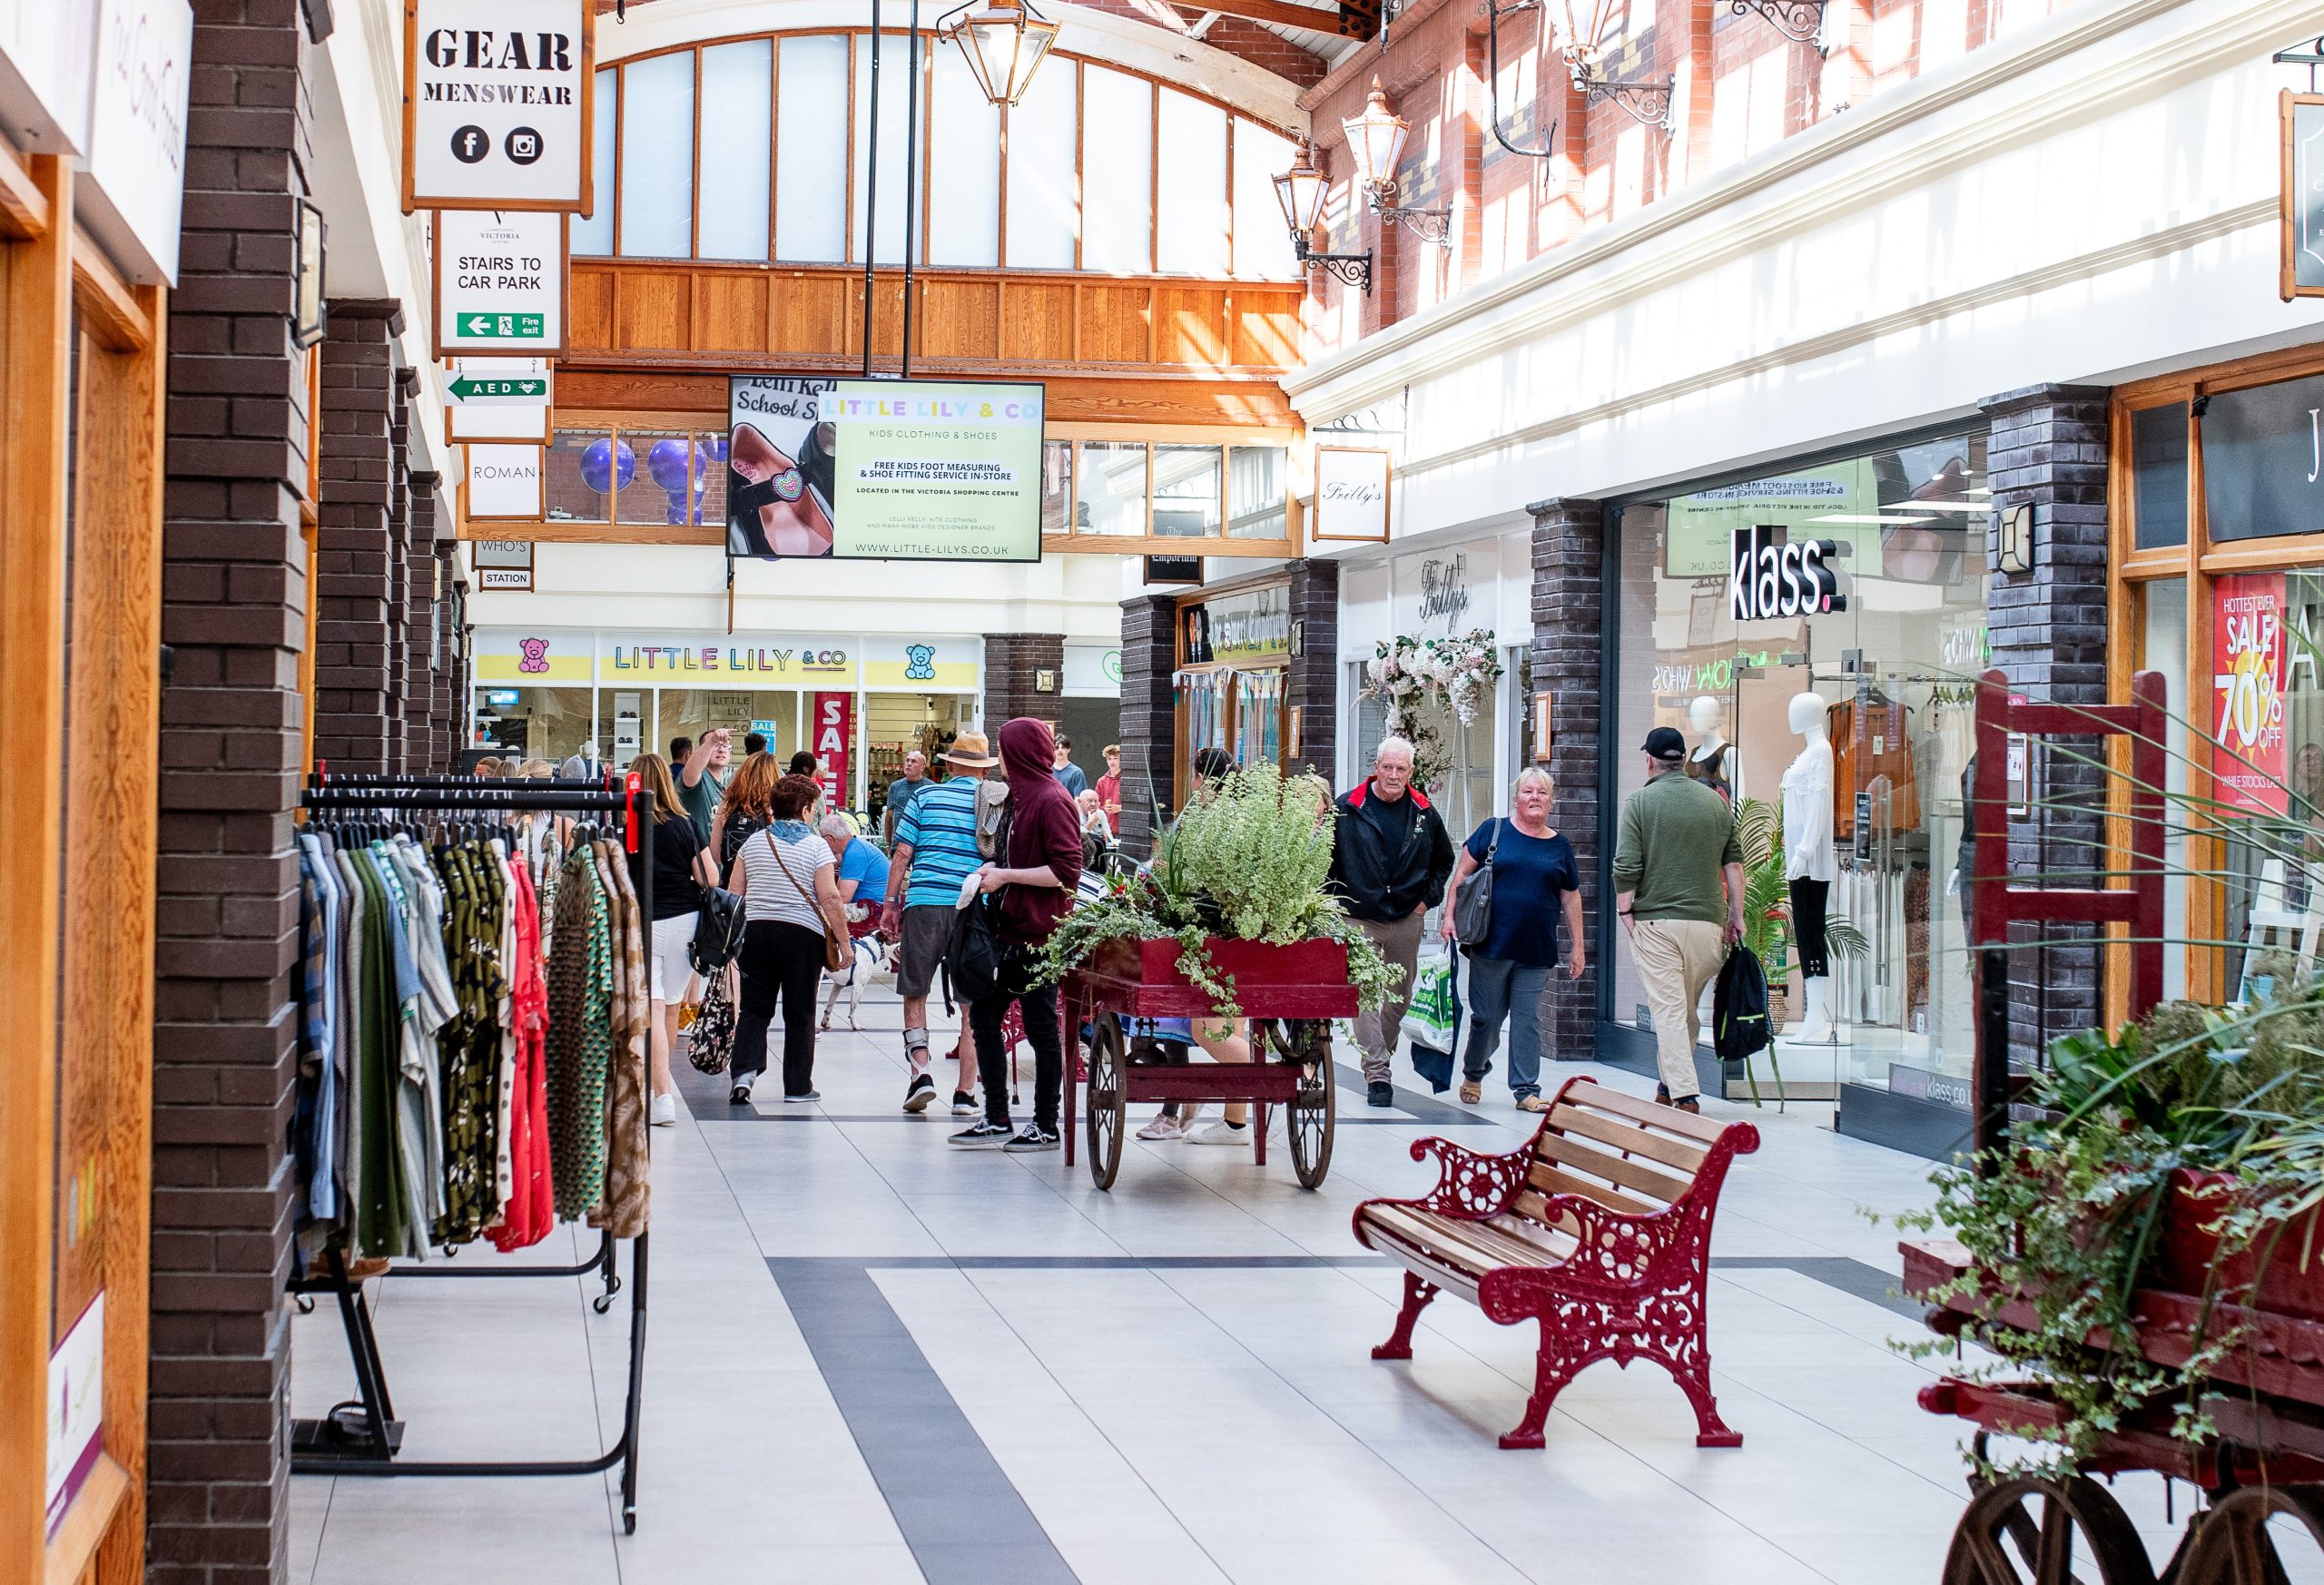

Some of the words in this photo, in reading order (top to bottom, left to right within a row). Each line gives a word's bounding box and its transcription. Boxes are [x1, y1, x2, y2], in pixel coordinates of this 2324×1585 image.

[426, 29, 573, 72] GEAR
[424, 83, 573, 105] MENSWEAR
[458, 256, 514, 271] STAIRS
[520, 258, 541, 271] TO
[458, 275, 491, 289] CAR
[498, 276, 541, 290] PARK
[522, 318, 539, 326] Fire
[522, 327, 539, 335] exit
[472, 383, 511, 394] AED
[737, 391, 799, 418] School
[825, 399, 906, 417] LITTLE
[917, 400, 969, 418] LILY
[979, 402, 994, 418] &
[1005, 403, 1038, 419] CO
[869, 429, 893, 438] KIDS
[896, 430, 950, 439] CLOTHING
[953, 431, 960, 439] &
[963, 432, 997, 440] SHOES
[474, 467, 536, 478] ROMAN
[874, 461, 895, 470] FREE
[897, 462, 918, 470] KIDS
[921, 462, 945, 471] FOOT
[947, 463, 1000, 472] MEASURING
[860, 469, 868, 477] &
[869, 469, 893, 478] SHOE
[896, 470, 931, 479] FITTING
[932, 471, 969, 480] SERVICE
[970, 472, 1012, 480] IN-STORE
[1323, 481, 1384, 507] Frilly's
[481, 540, 527, 553] WHO'S
[855, 544, 1009, 555] WWW.LITTLE-LILYS.CO.UK
[486, 574, 527, 583] STATION
[2223, 596, 2255, 614] HOTTEST
[2256, 595, 2274, 612] EVER
[2226, 615, 2272, 655] SALE
[615, 645, 718, 670] LITTLE
[730, 648, 793, 671] LILY
[803, 650, 814, 665] &
[818, 650, 846, 665] CO
[713, 696, 750, 704] LITTLE
[727, 707, 750, 716] LILY
[751, 721, 775, 731] SALE
[2259, 726, 2281, 749] OFF
